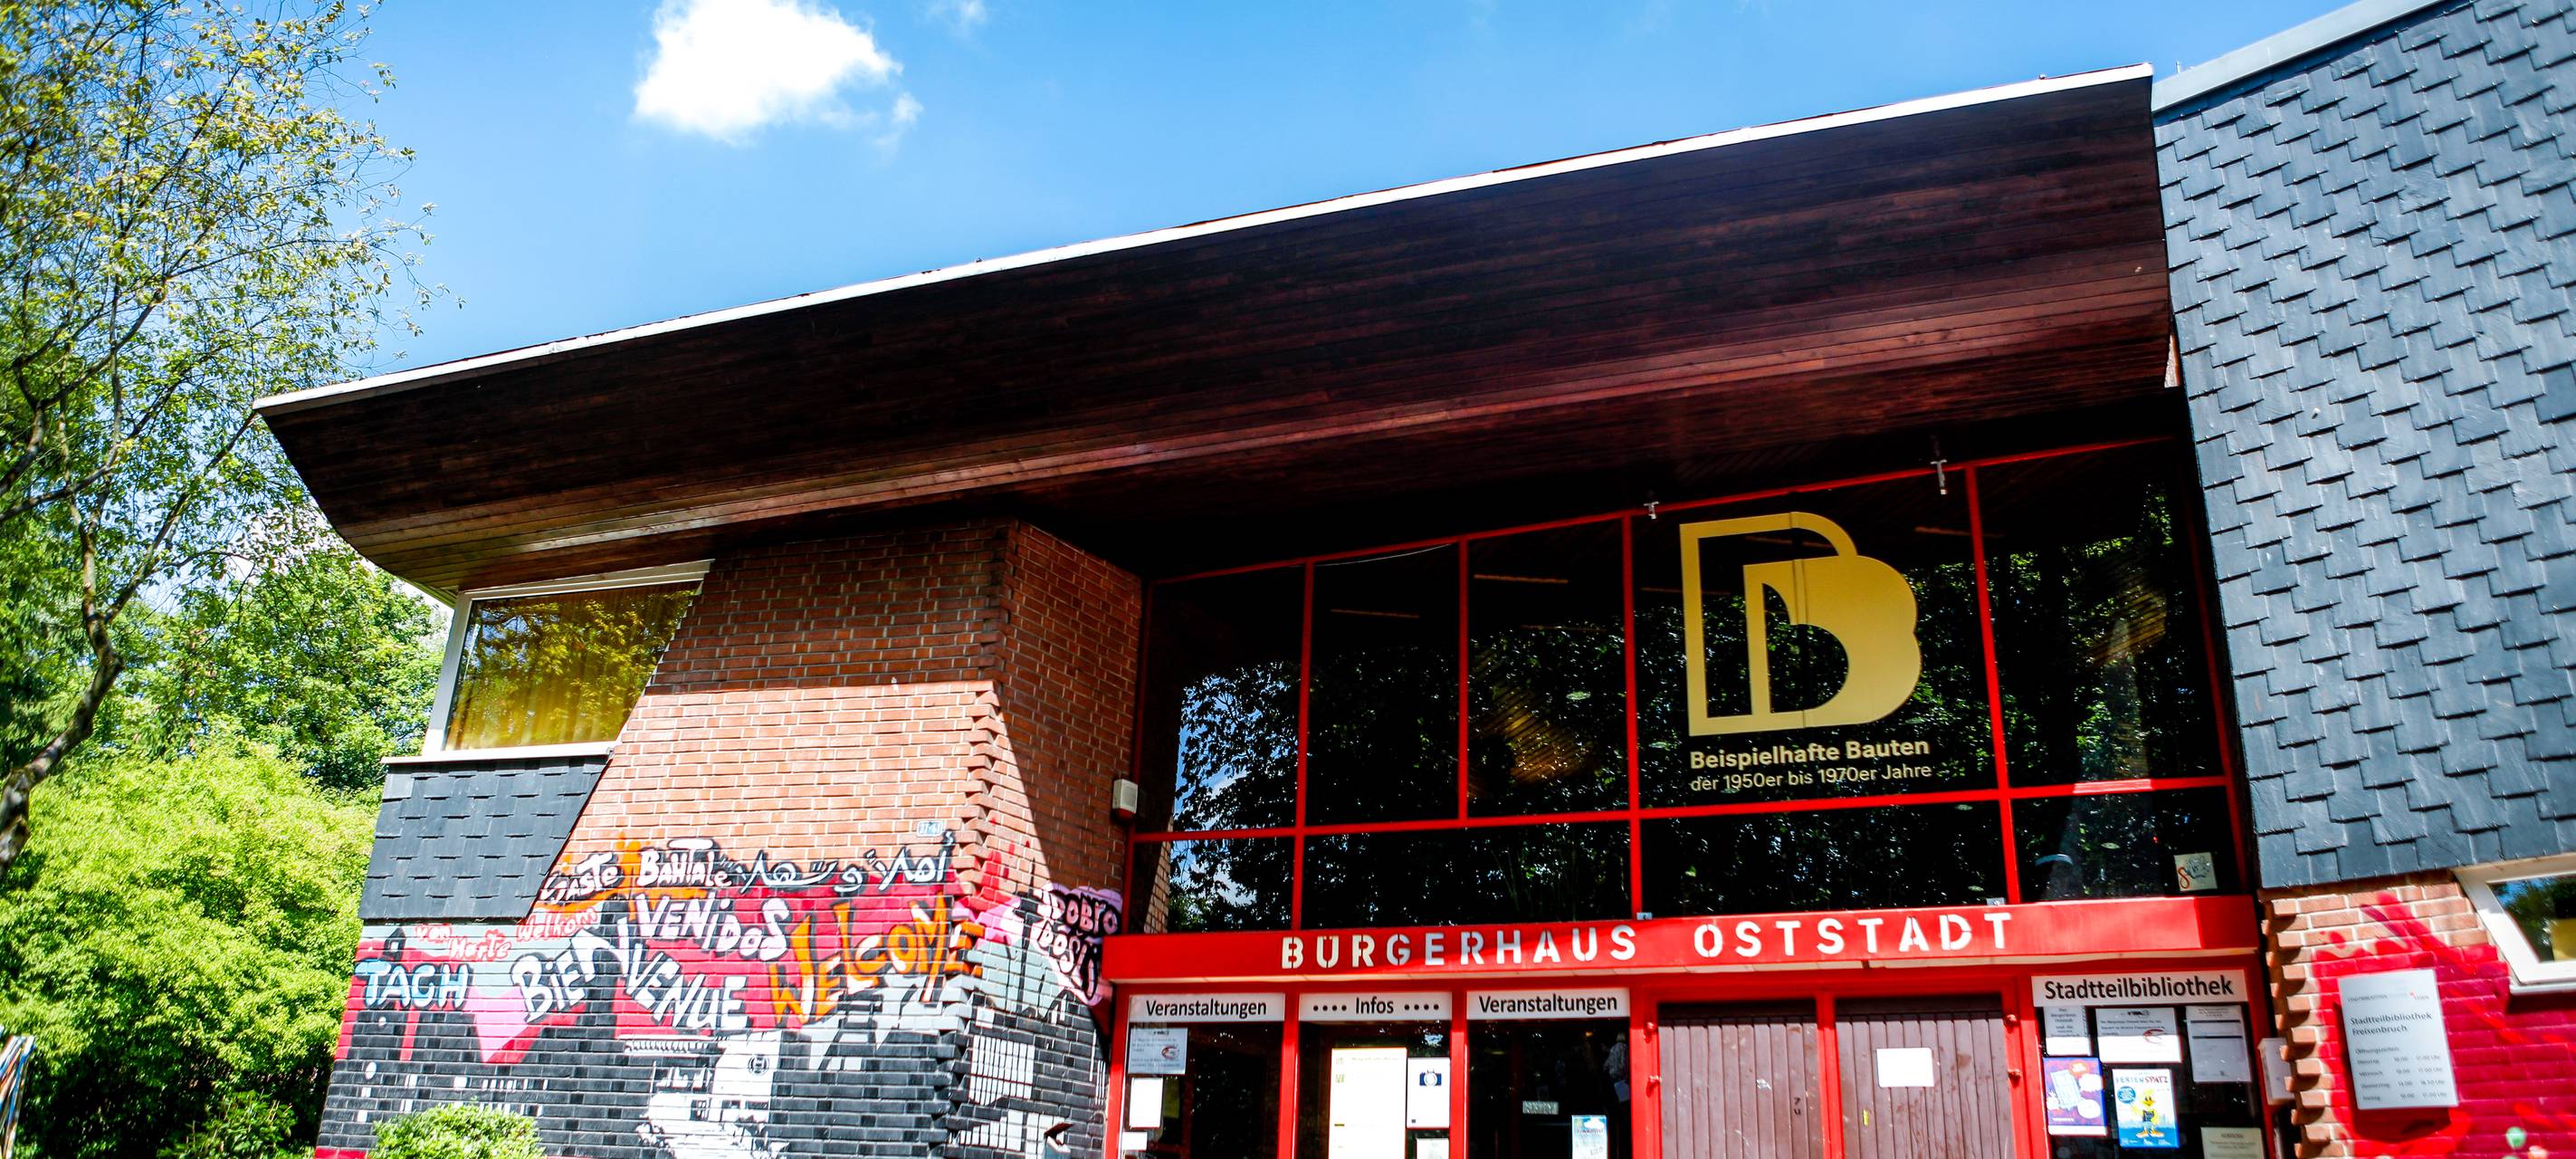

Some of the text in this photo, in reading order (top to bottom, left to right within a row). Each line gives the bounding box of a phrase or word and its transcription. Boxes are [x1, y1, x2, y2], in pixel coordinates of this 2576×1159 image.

[1690, 740, 1931, 771] Beispielhafte Bauten
[1691, 762, 1932, 791] der 1950er bis 1970er Jahre
[1282, 913, 2012, 969] BÜRGERHAUS OSTSTADT
[2044, 974, 2234, 1000] Stadtteilbibliothek
[1146, 997, 1267, 1020] Veranstaltungen
[1355, 996, 1394, 1015] Infos
[1479, 993, 1617, 1016] Veranstaltungen
[2350, 1011, 2433, 1026] Stadtteilbibliothek
